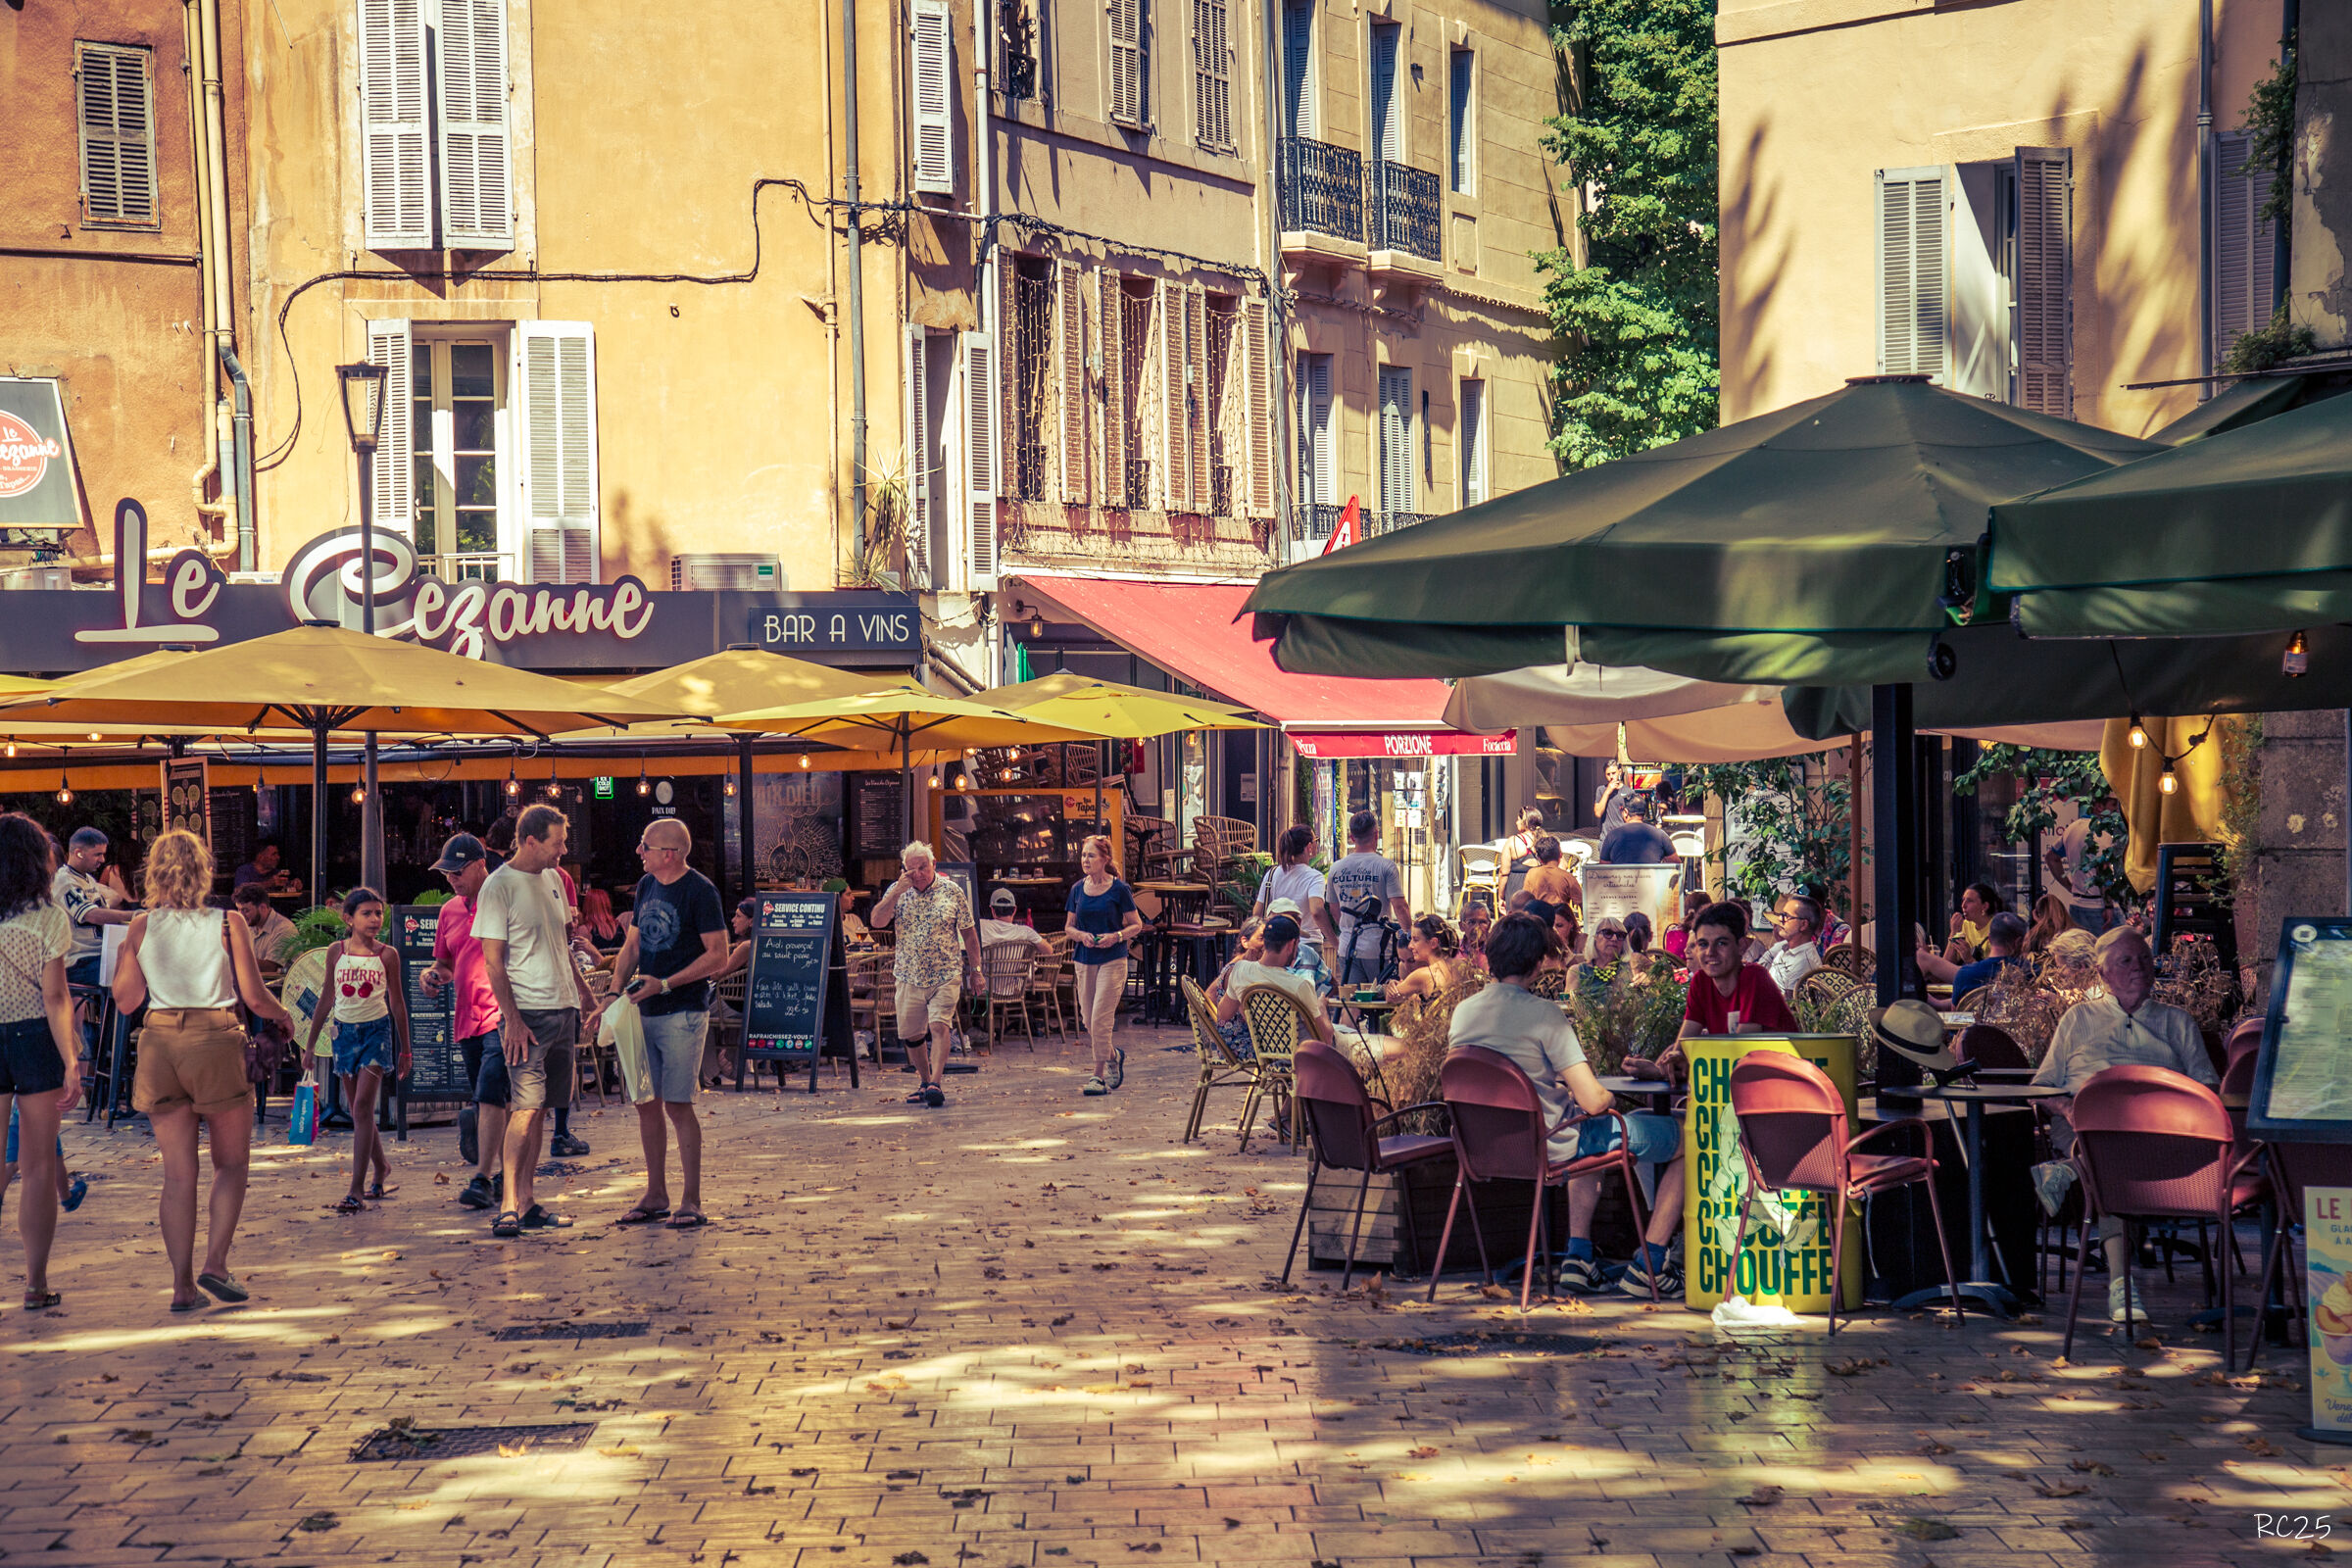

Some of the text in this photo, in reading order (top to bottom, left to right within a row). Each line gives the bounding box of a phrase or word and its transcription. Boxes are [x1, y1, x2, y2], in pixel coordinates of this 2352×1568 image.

[2, 426, 24, 442] Le
[0, 439, 59, 466] ezanne
[74, 508, 655, 661] Le Cezanne
[764, 613, 909, 643] BAR A VINS
[1296, 738, 1317, 755] Pizza
[1384, 733, 1433, 756] PORZIONE
[1333, 875, 1380, 884] CULTURE
[774, 903, 826, 913] SERVICE CONTINU
[336, 968, 383, 986] CHERRY
[2316, 1198, 2342, 1220] LE
[1699, 1247, 1836, 1297] CHOUFFE
